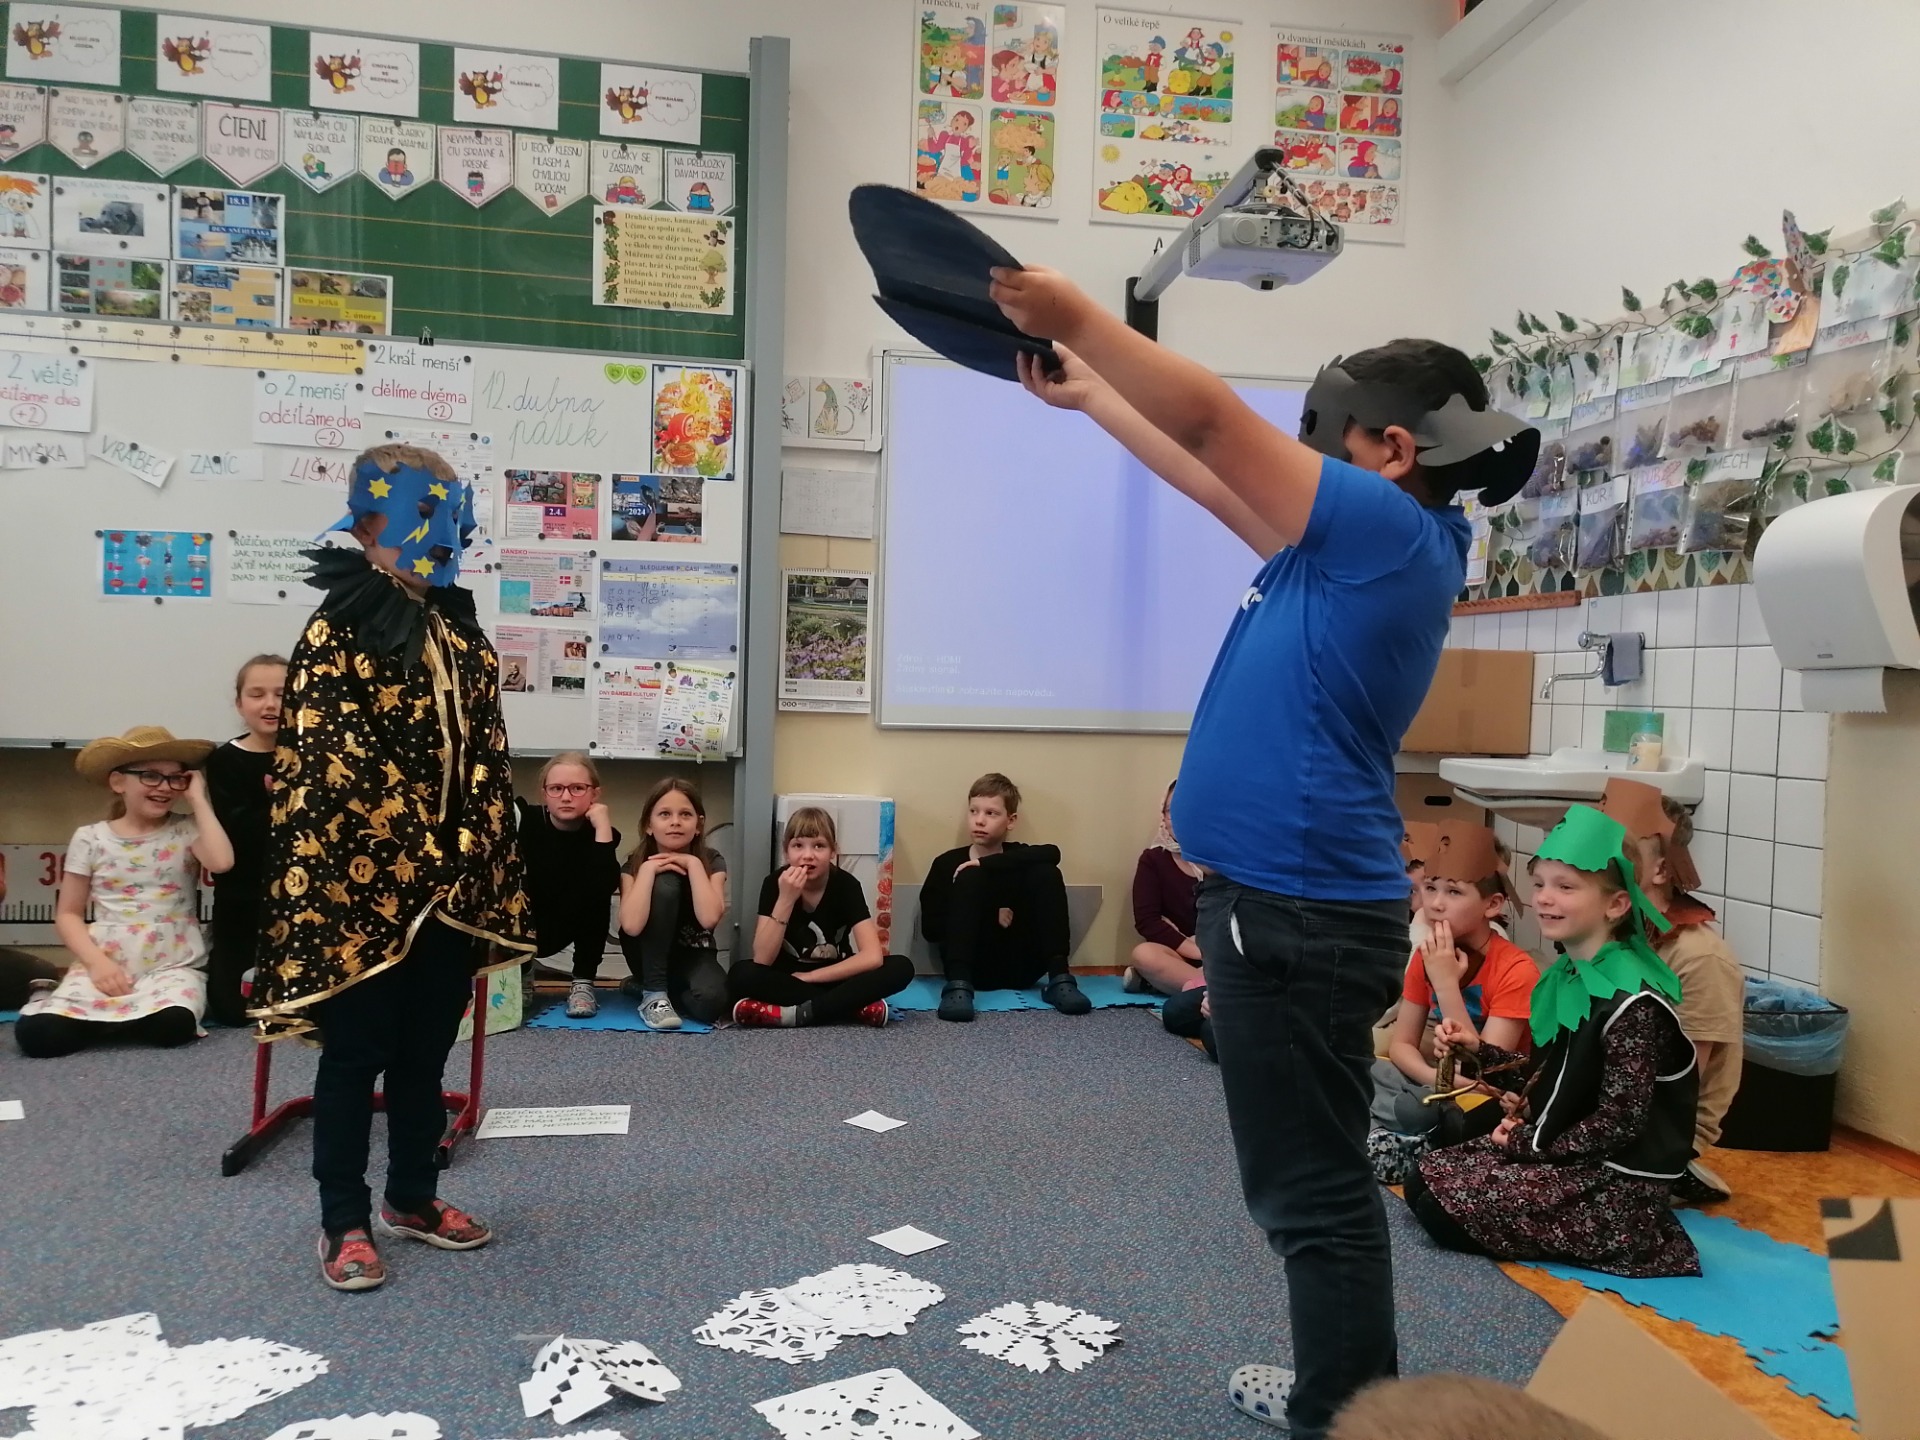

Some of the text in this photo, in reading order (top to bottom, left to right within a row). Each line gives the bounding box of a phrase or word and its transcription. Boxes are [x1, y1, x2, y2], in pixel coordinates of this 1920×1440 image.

[1103, 15, 1160, 31] O veliké řepě
[1277, 32, 1285, 40] O
[219, 113, 267, 141] ČTENÍ
[641, 152, 651, 163] SE
[674, 157, 684, 167] NA
[97, 326, 108, 334] 30
[132, 329, 145, 338] 40
[203, 334, 215, 342] 60
[238, 336, 250, 345] 70
[307, 341, 319, 349] 90
[340, 343, 354, 352] 100
[8, 353, 23, 380] 2
[374, 344, 462, 373] 2 krát menší
[0, 384, 81, 407] čítáme dva
[285, 374, 296, 397] 2
[300, 382, 350, 401] menší
[371, 377, 468, 404] dělíme dvěma
[513, 376, 606, 415] dubna
[259, 400, 362, 429] odčítáme dva
[9, 442, 68, 463] MYŠKA
[102, 434, 167, 478] VRABEC
[290, 456, 348, 486] LIŠKA
[628, 508, 646, 516] 2024
[39, 852, 67, 886] 3
